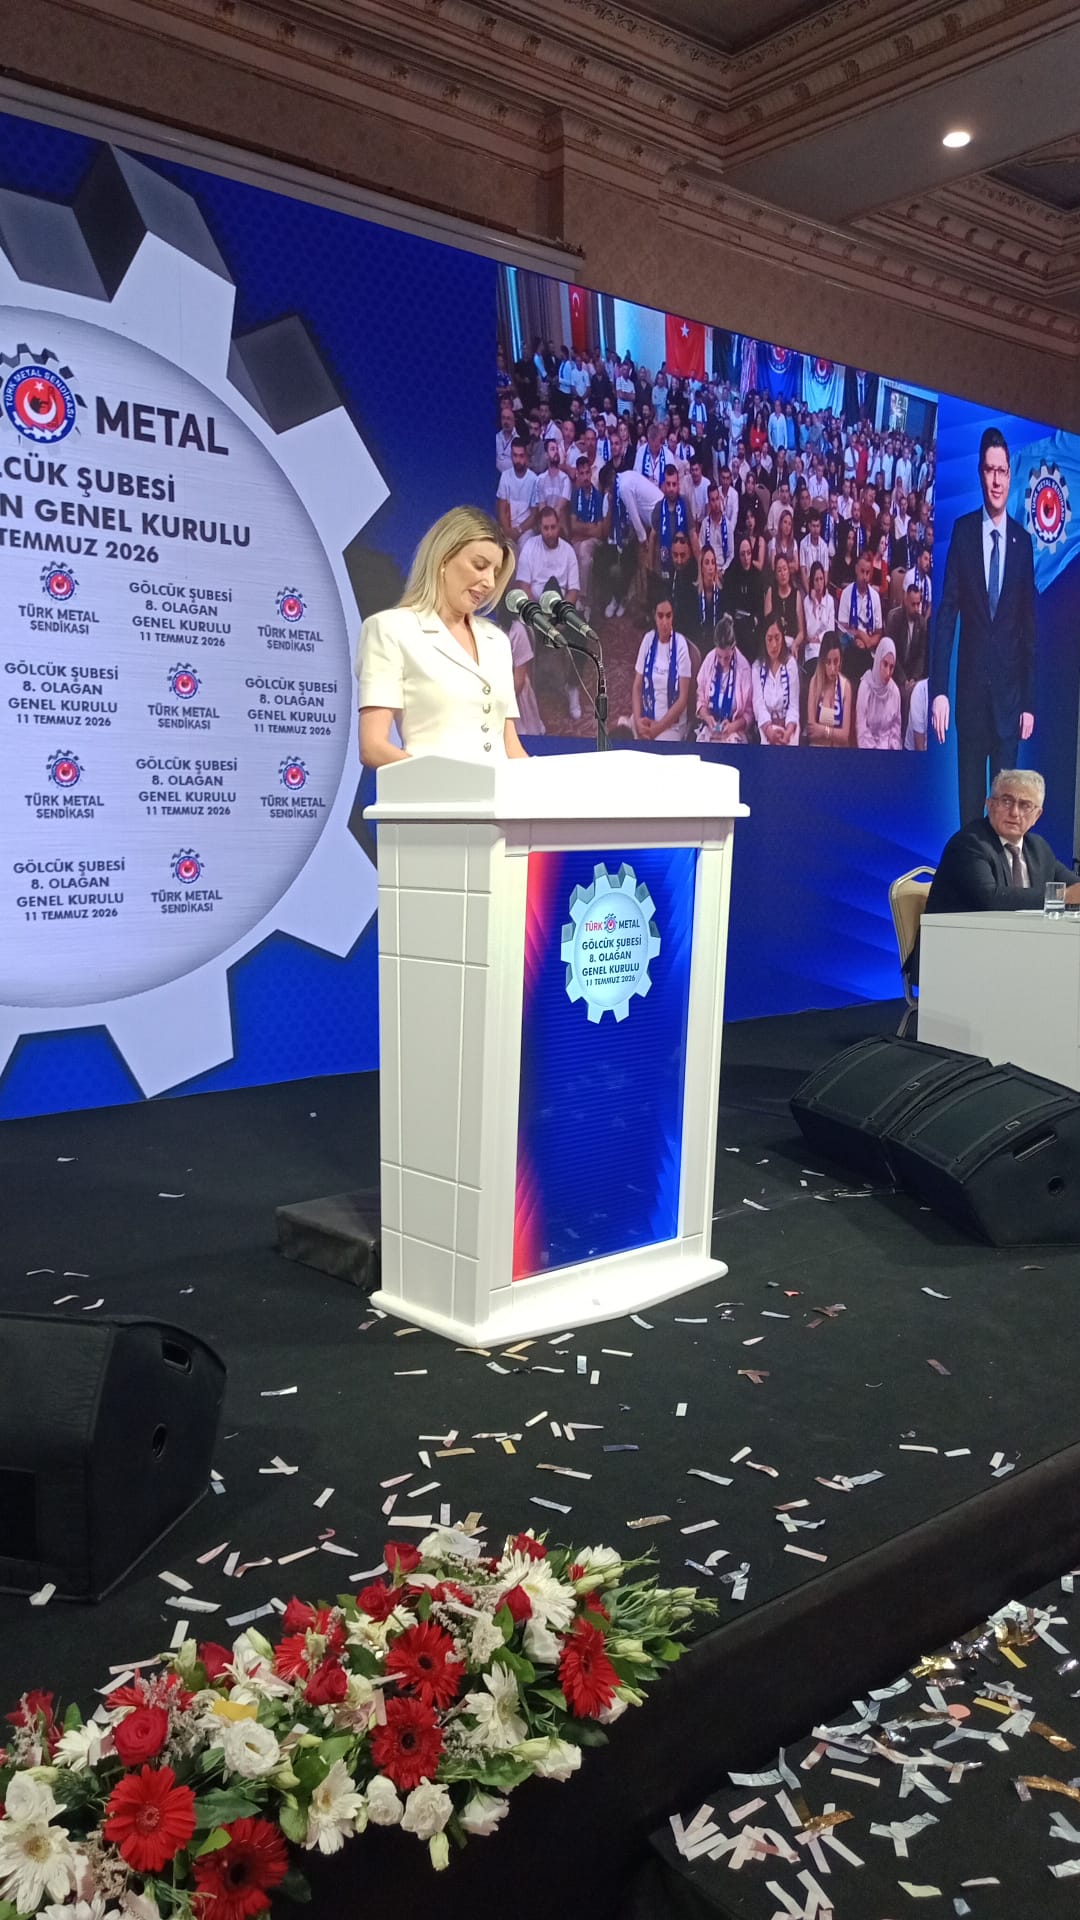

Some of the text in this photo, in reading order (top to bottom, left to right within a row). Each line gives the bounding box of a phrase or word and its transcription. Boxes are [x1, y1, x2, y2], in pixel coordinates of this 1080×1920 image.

[96, 396, 229, 456] METAL
[0, 452, 175, 502] CÜK ŞUBESİ
[34, 499, 132, 533] GENEL
[142, 512, 250, 547] KURULU
[105, 541, 159, 563] 2026
[129, 580, 232, 603] GÖLCÜK ŞUBESİ
[18, 603, 100, 623] TÜRK METAL
[145, 600, 218, 616] 8. OLAĞAN
[30, 620, 89, 635] SENDİKASI
[132, 616, 231, 634] GENEL KURULU
[140, 632, 225, 647] 11 TEMMUZ 2026
[257, 625, 324, 642] TÜRK METAL
[267, 640, 314, 652] SENDİKASI
[4, 660, 118, 681] GÖLCÜK ŞUBESİ
[23, 680, 102, 695] 8. OLAĞAN
[245, 675, 337, 695] GÖLCÜK ŞUBESİ
[8, 697, 117, 713] GENEL KURULU
[260, 693, 324, 707] 8. OLAĞAN
[147, 702, 220, 718] TÜRK METAL
[247, 709, 336, 723] GENEL KURULU
[17, 713, 111, 727] 11 TEMMUZ 2026
[158, 717, 210, 730] SENDİKASI
[254, 724, 331, 735] 11 TEMMUZ 2026
[136, 756, 237, 774] GÖLCÜK ŞUBESİ
[152, 774, 223, 786] 8. OLAĞAN
[24, 792, 105, 806] TÜRK METAL
[139, 791, 236, 802] GENEL KURULU
[260, 794, 326, 807] TÜRK METAL
[36, 807, 94, 819] SENDİKASI
[146, 806, 231, 815] 11 TEMMUZ 2026
[270, 807, 317, 818] SENDİKASI
[13, 856, 125, 876] GÖLCÜK ŞUBESİ
[31, 875, 109, 889] 8. OLAĞAN
[16, 892, 124, 907] GENEL KURULU
[151, 889, 223, 903] TÜRK METAL
[25, 908, 118, 921] 11 TEMMUZ 2026
[161, 901, 213, 914] SENDİKASI
[585, 920, 640, 931] TÜRK METAL
[582, 934, 641, 950] GÖLCÜK ŞUBESİ
[589, 954, 596, 962] 8.
[582, 963, 639, 976] GENEL KURULU
